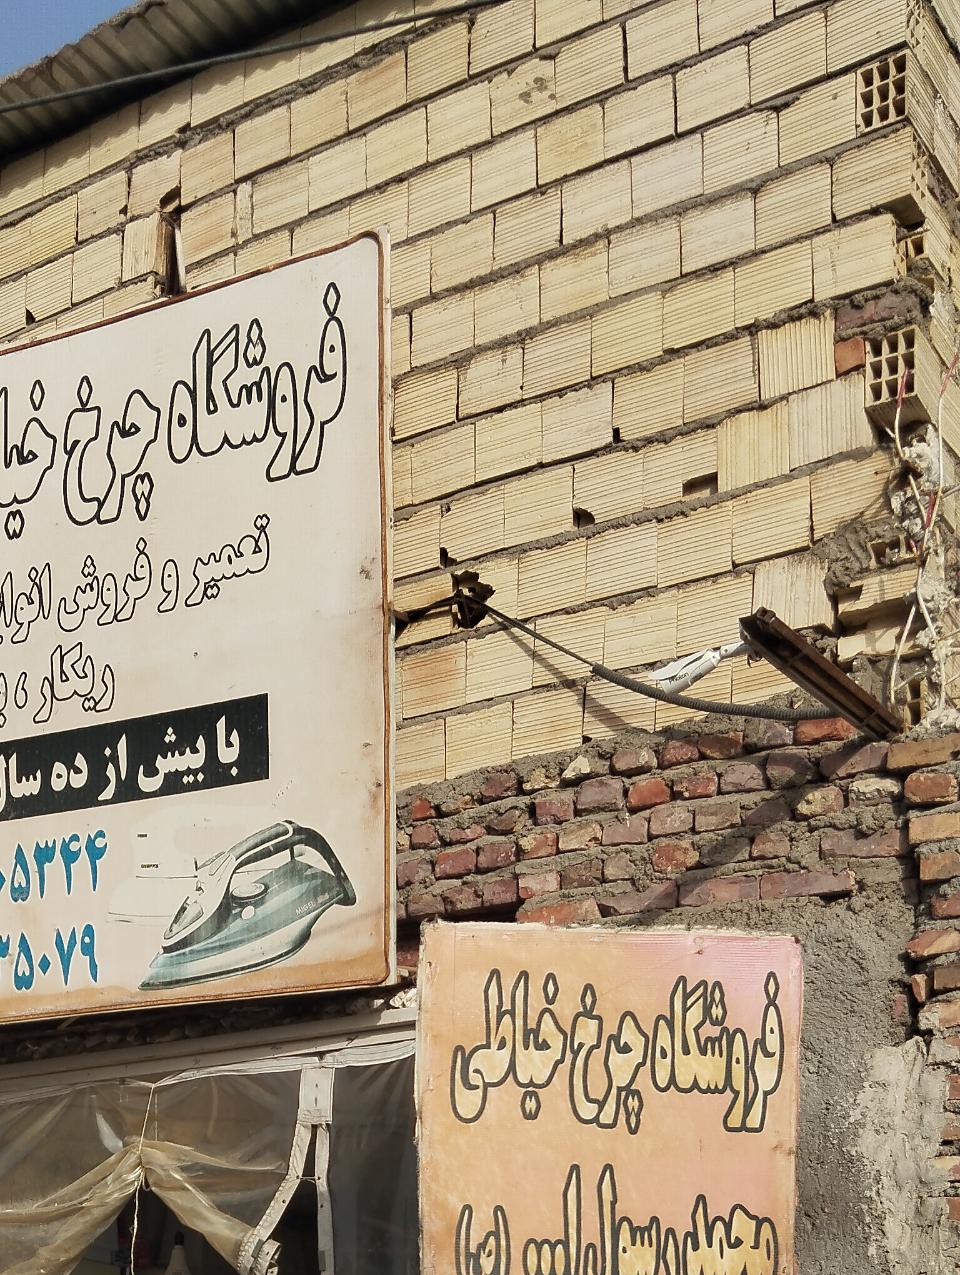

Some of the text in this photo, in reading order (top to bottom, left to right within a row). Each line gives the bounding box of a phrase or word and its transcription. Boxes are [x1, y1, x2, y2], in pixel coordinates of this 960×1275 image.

[167, 282, 347, 482] فروشگاه
[63, 376, 161, 526] چرخ
[57, 536, 152, 632] فروش
[157, 559, 179, 613] و
[184, 513, 270, 607] تعمیر
[33, 642, 115, 724] ریکار
[50, 752, 88, 792] ده
[97, 733, 127, 800] از
[137, 726, 206, 792] بیش
[215, 714, 240, 777] با
[450, 967, 784, 1135] فروشگاه چرخ خیاطی
